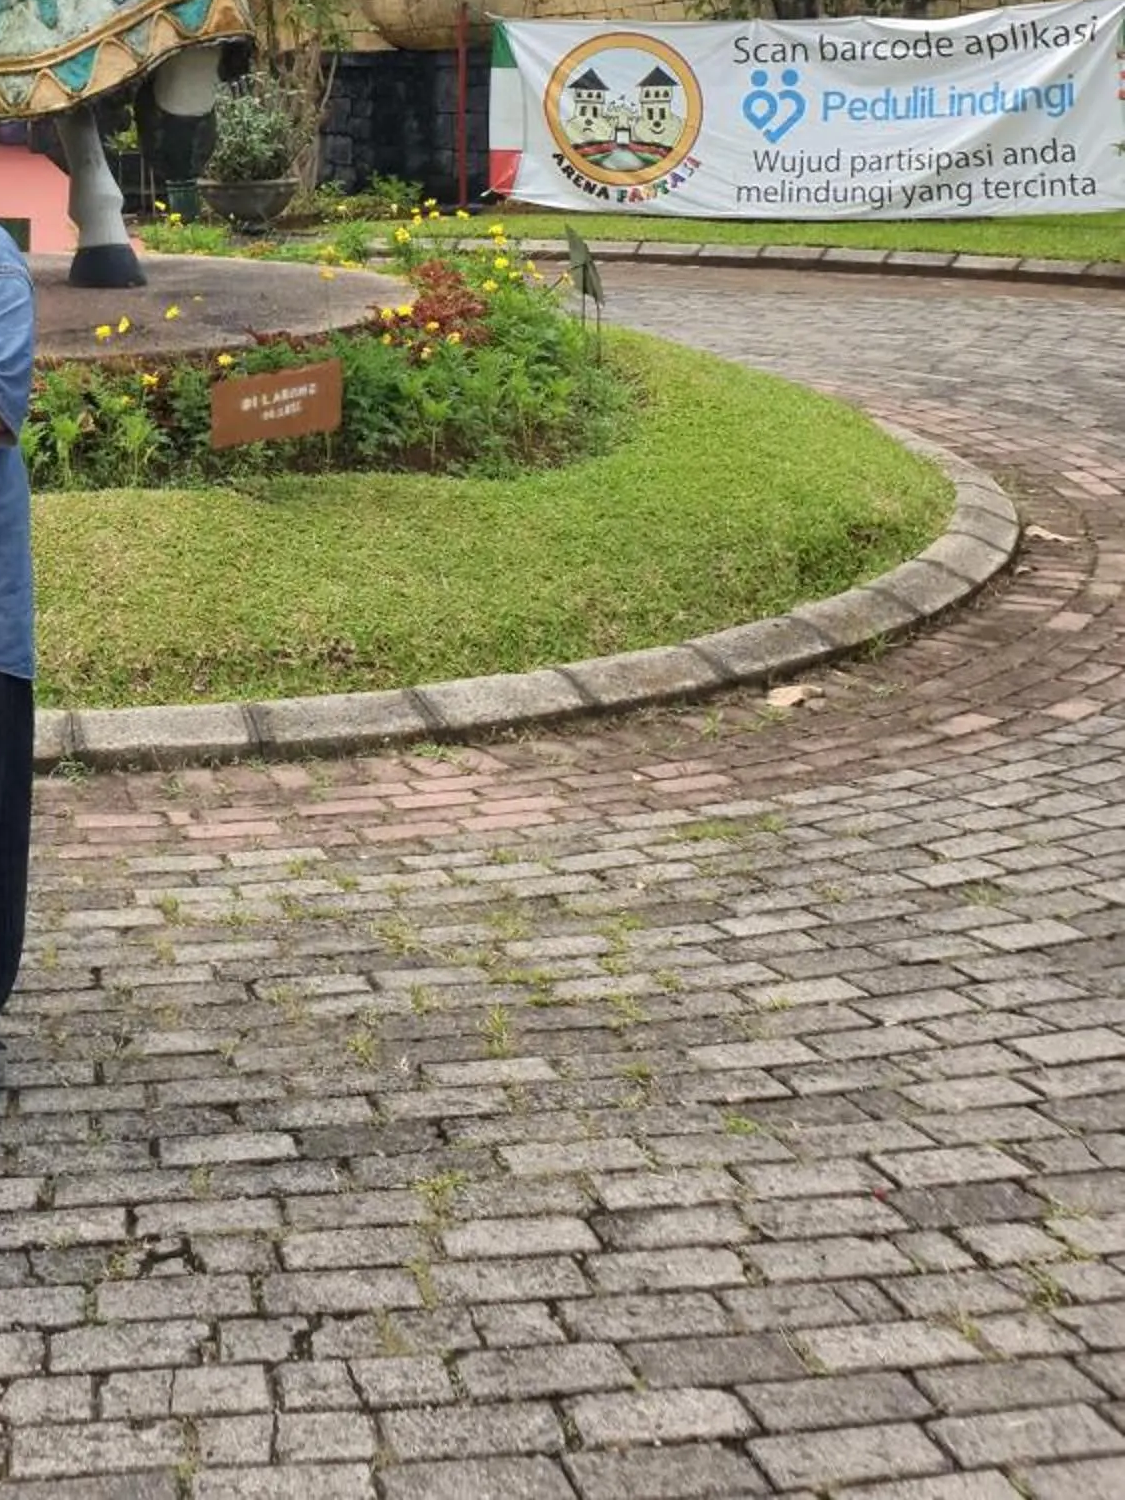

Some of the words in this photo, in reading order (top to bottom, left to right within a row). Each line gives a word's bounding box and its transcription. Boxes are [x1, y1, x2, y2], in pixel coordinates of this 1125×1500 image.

[733, 35, 810, 65] Scan
[818, 31, 954, 62] barcode
[964, 14, 1098, 60] aplikasi
[820, 73, 1075, 123] PeduliLindungi
[552, 152, 610, 200] ARENA
[753, 148, 842, 179] Wujud
[850, 143, 994, 178] partisipasi
[1002, 137, 1077, 166] anda
[736, 179, 893, 210] melindungi
[901, 182, 973, 210] yang
[983, 172, 1097, 200] tercinta
